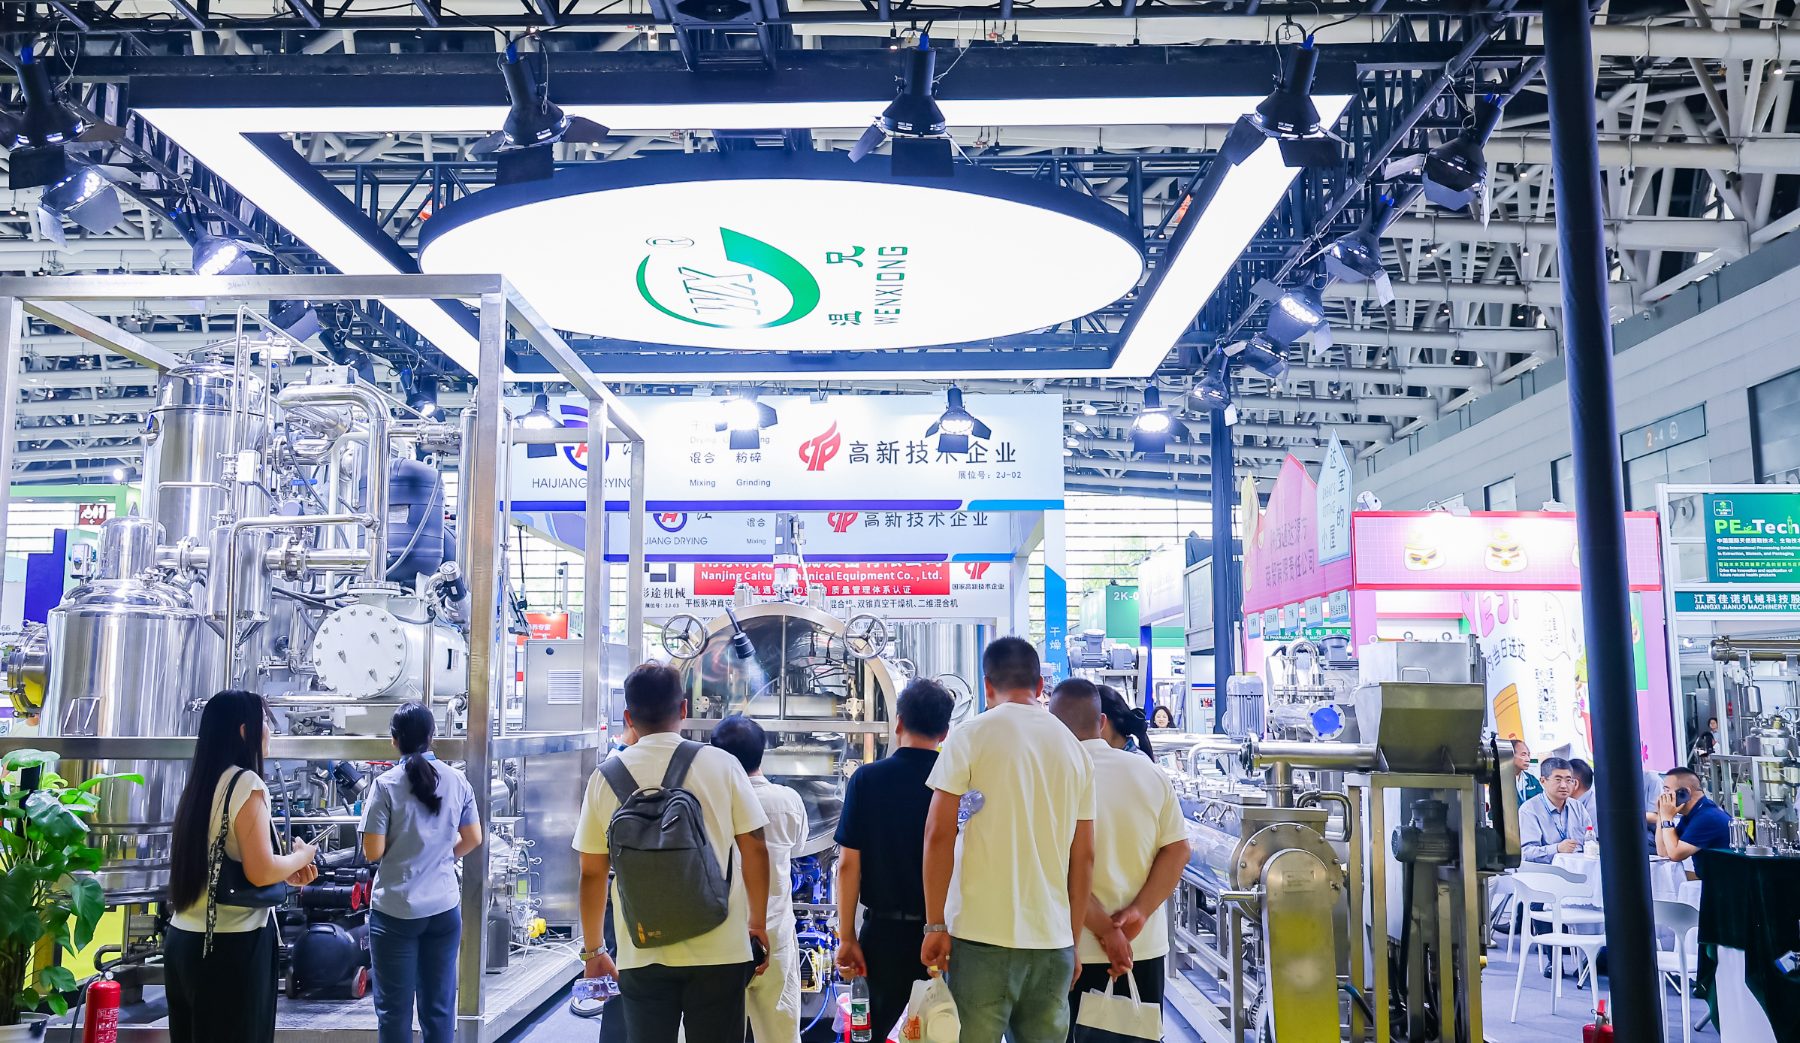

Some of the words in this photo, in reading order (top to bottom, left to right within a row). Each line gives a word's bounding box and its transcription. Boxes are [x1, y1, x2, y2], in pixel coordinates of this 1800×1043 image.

[874, 246, 908, 325] WENXIONG
[690, 451, 715, 464] 混合
[736, 451, 762, 464] 粉碎
[532, 478, 587, 488] HAIJIANG
[690, 479, 716, 488] Mixing
[736, 479, 771, 488] Grinding
[864, 512, 988, 528] 高新技术企业
[674, 537, 708, 545] DRYING
[701, 571, 742, 582] Nanjing
[744, 571, 772, 580] Caitu
[836, 571, 895, 582] Equipment
[922, 571, 943, 580] Ltd.
